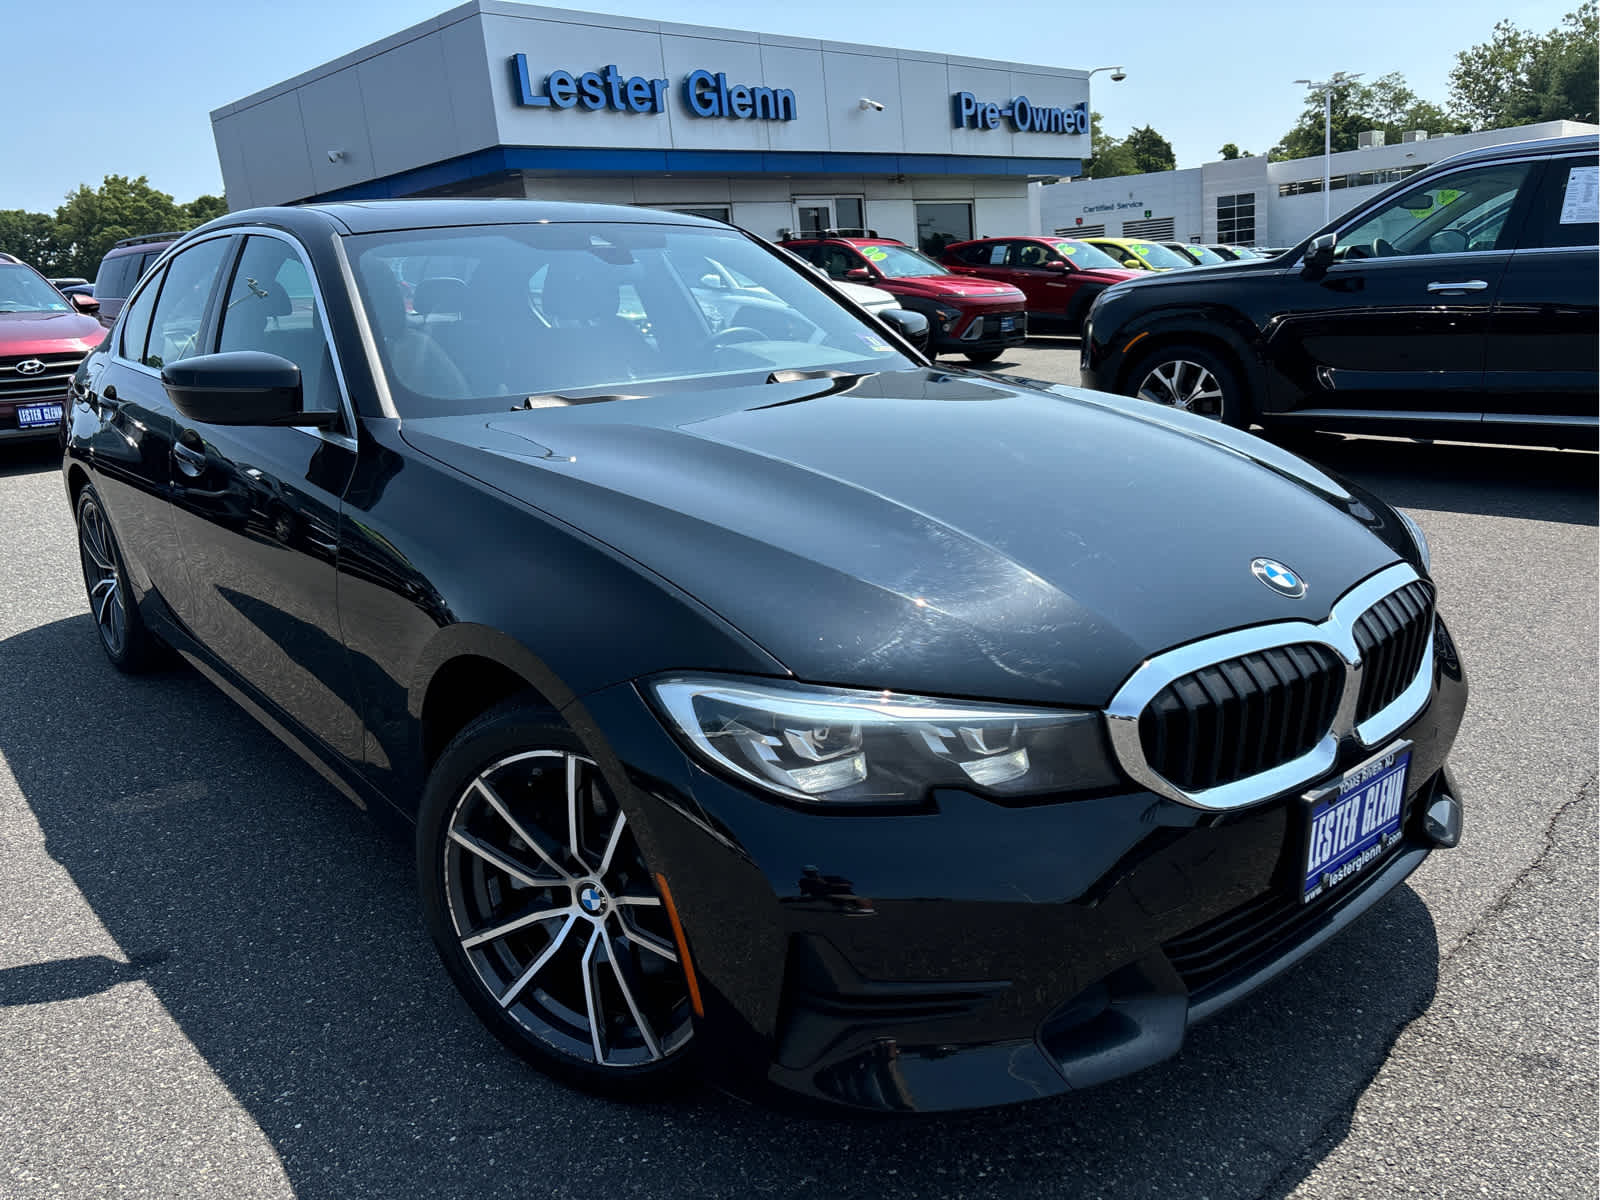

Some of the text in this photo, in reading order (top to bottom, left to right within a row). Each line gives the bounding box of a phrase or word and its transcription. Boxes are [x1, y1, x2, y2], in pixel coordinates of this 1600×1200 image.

[511, 53, 797, 121] Lester Glenn
[953, 91, 1089, 134] Pre-Owned
[1083, 201, 1144, 213] Certified Service
[18, 408, 42, 422] LESTER
[1307, 767, 1406, 873] LESTER GLENN
